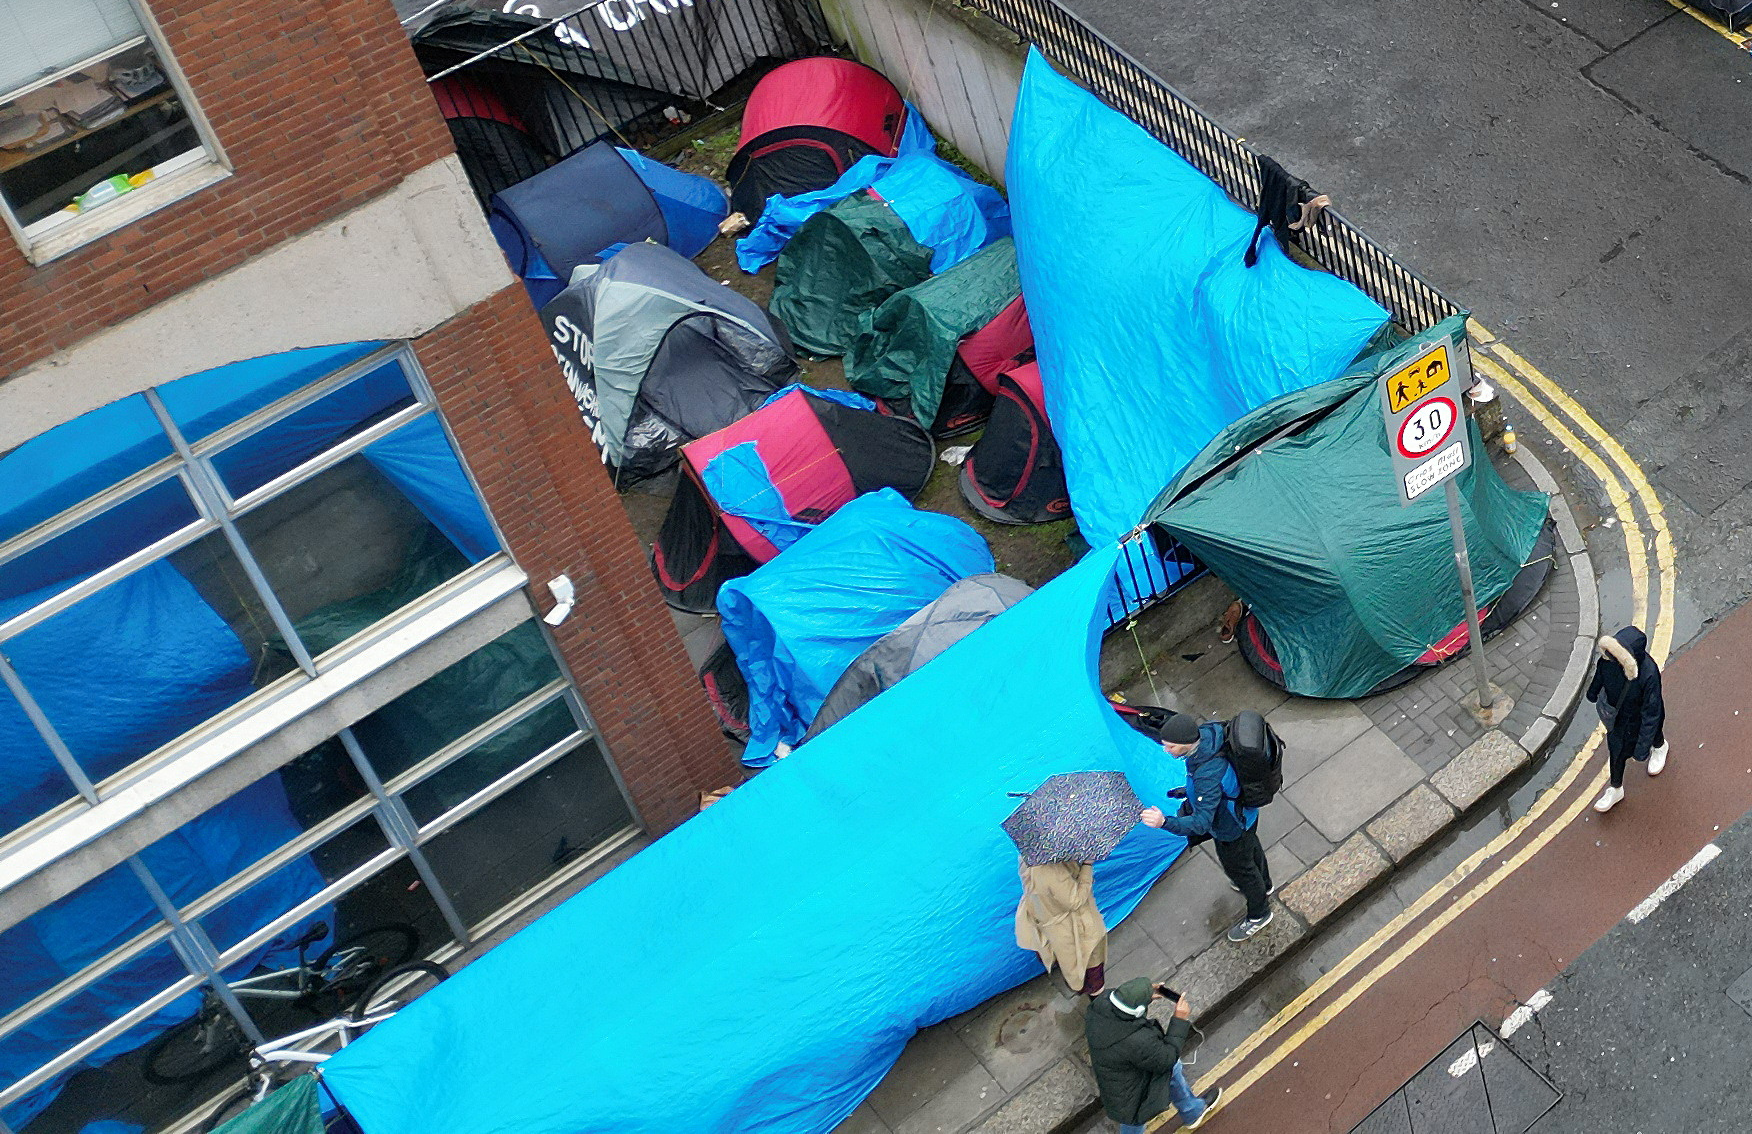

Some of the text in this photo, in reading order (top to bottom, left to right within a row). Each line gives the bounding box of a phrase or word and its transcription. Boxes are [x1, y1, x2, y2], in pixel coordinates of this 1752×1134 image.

[1413, 409, 1442, 440] 30
[1410, 455, 1461, 494] SLOW ZONE
